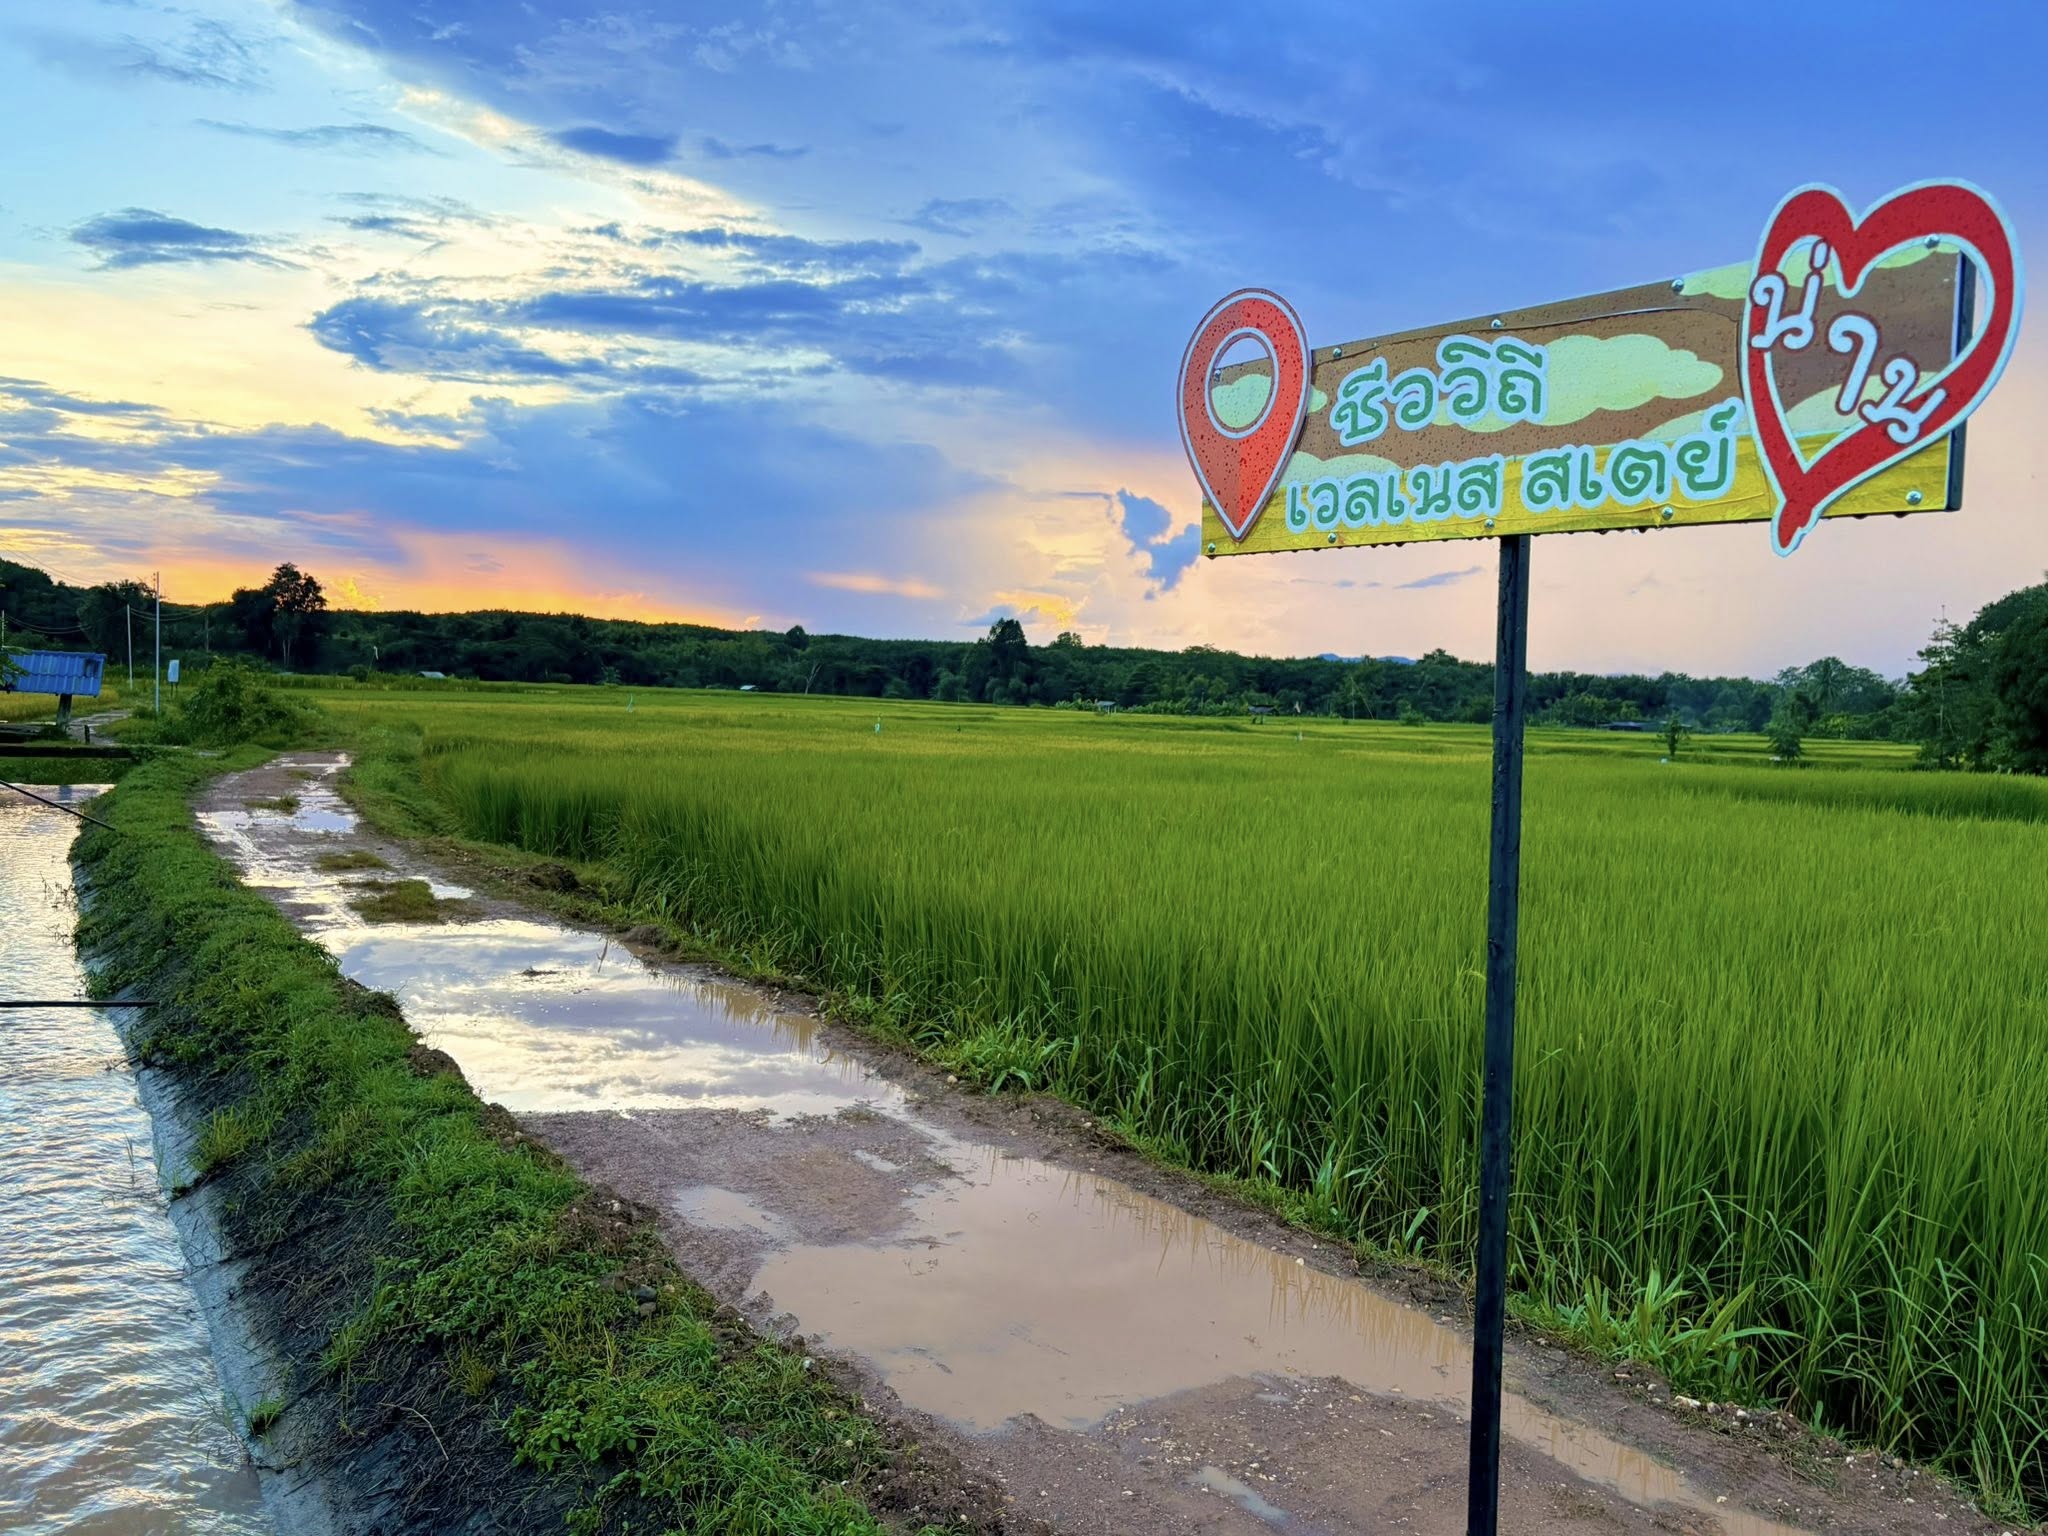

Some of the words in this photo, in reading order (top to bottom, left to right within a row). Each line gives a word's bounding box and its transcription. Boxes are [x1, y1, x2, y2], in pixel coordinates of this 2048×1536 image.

[1334, 340, 1544, 441] ชีววิถี
[1750, 240, 1947, 444] น่าน
[1288, 459, 1500, 527] เวลเนส
[1526, 405, 1737, 506] สเตย์
